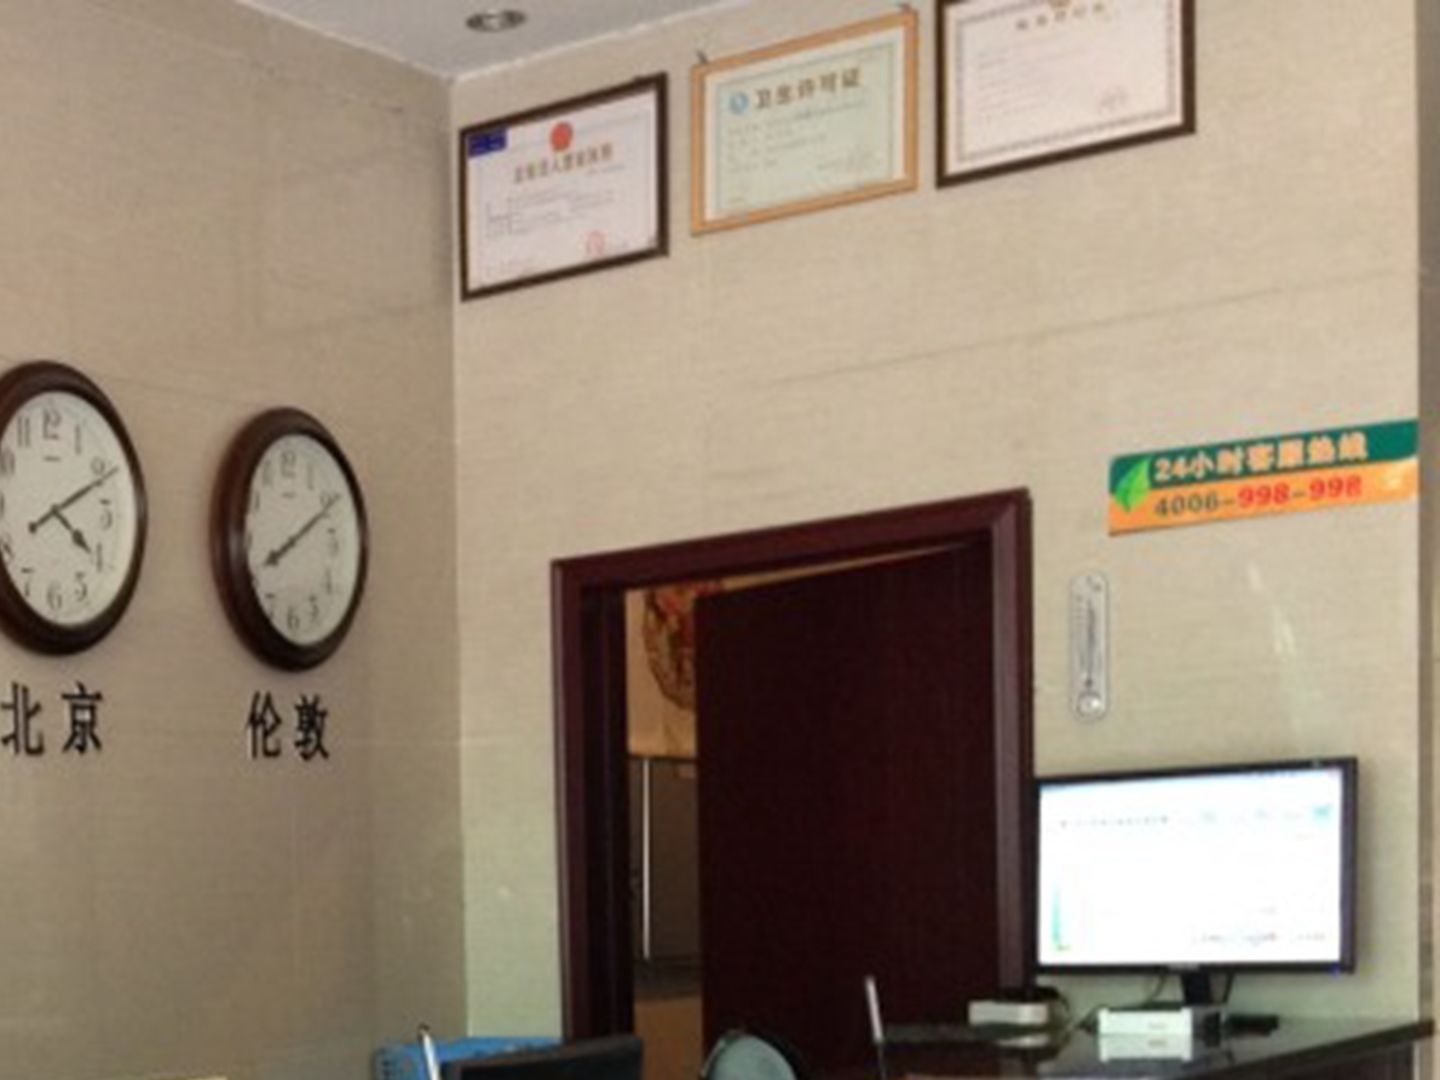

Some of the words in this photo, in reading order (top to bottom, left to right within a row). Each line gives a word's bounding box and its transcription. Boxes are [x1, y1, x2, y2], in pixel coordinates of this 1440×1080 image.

[43, 409, 61, 440] 12
[0, 682, 103, 755] 北京
[246, 691, 330, 760] 伦敦
